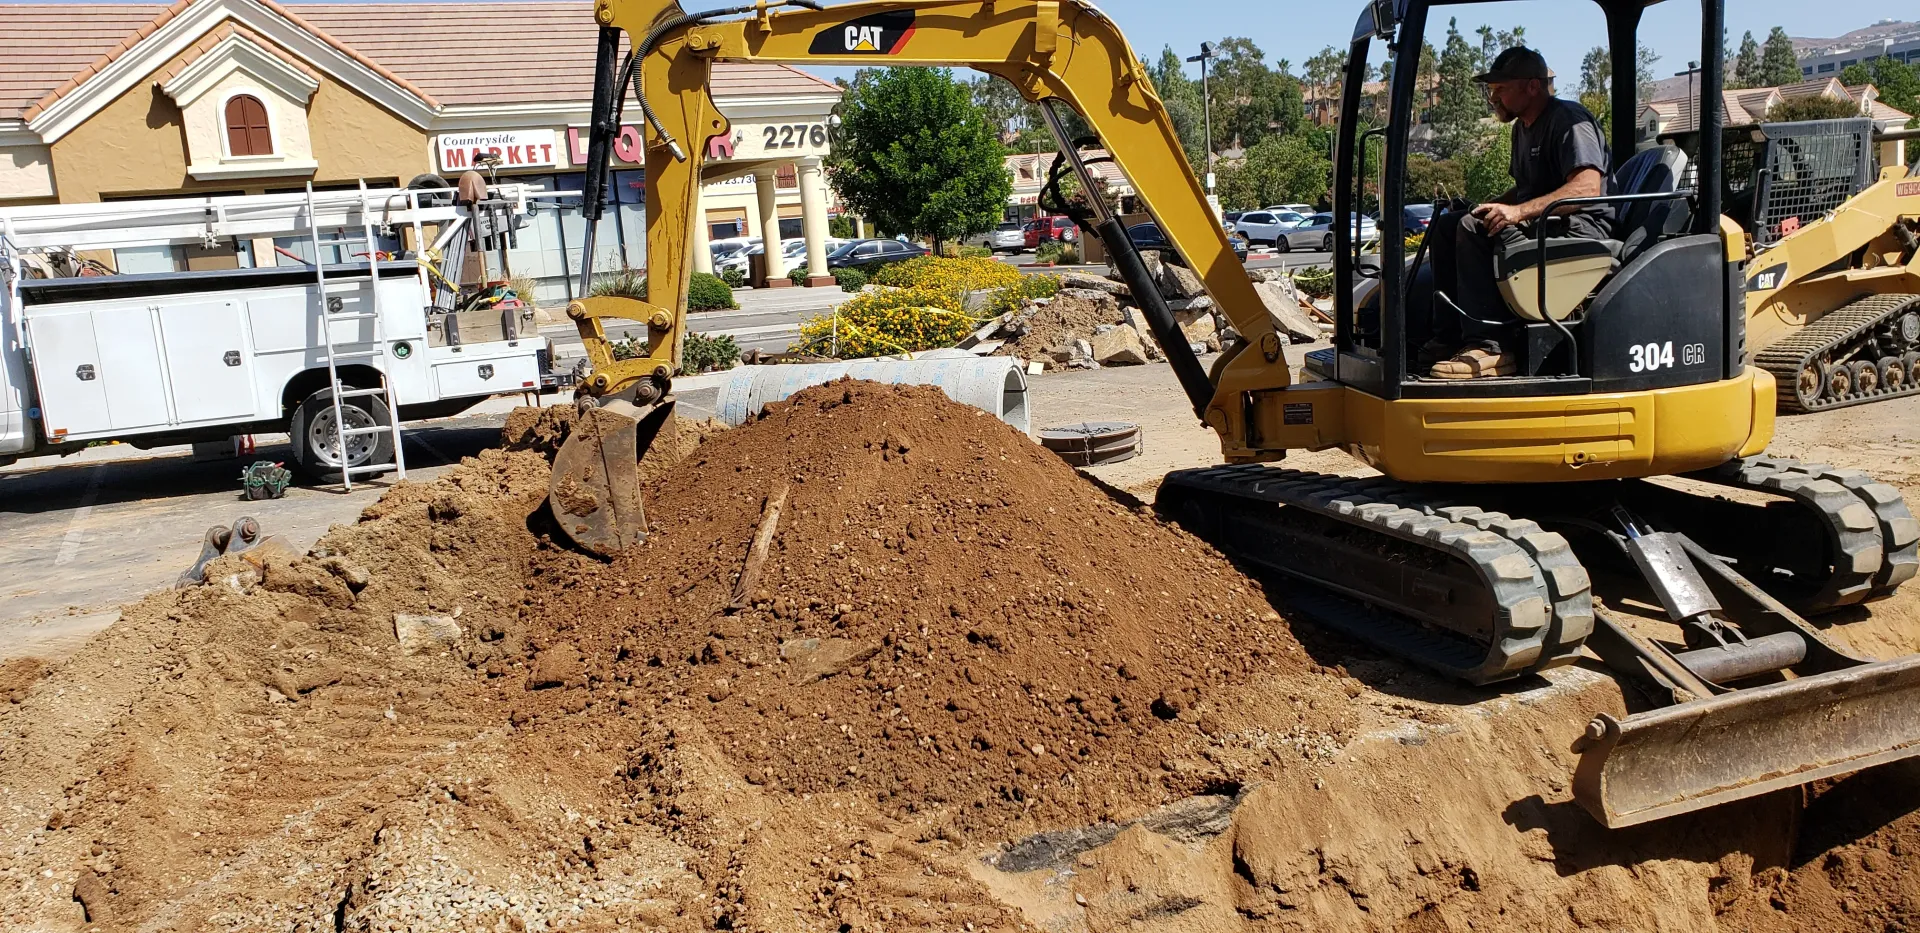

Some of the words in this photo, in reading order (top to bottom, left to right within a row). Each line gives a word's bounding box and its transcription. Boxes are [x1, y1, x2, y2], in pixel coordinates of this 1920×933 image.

[845, 26, 883, 50] CAT
[443, 134, 516, 146] Countryside
[568, 126, 734, 165] LQR
[1758, 272, 1776, 289] CAT
[1629, 341, 1675, 373] 304
[1682, 343, 1705, 366] CR
